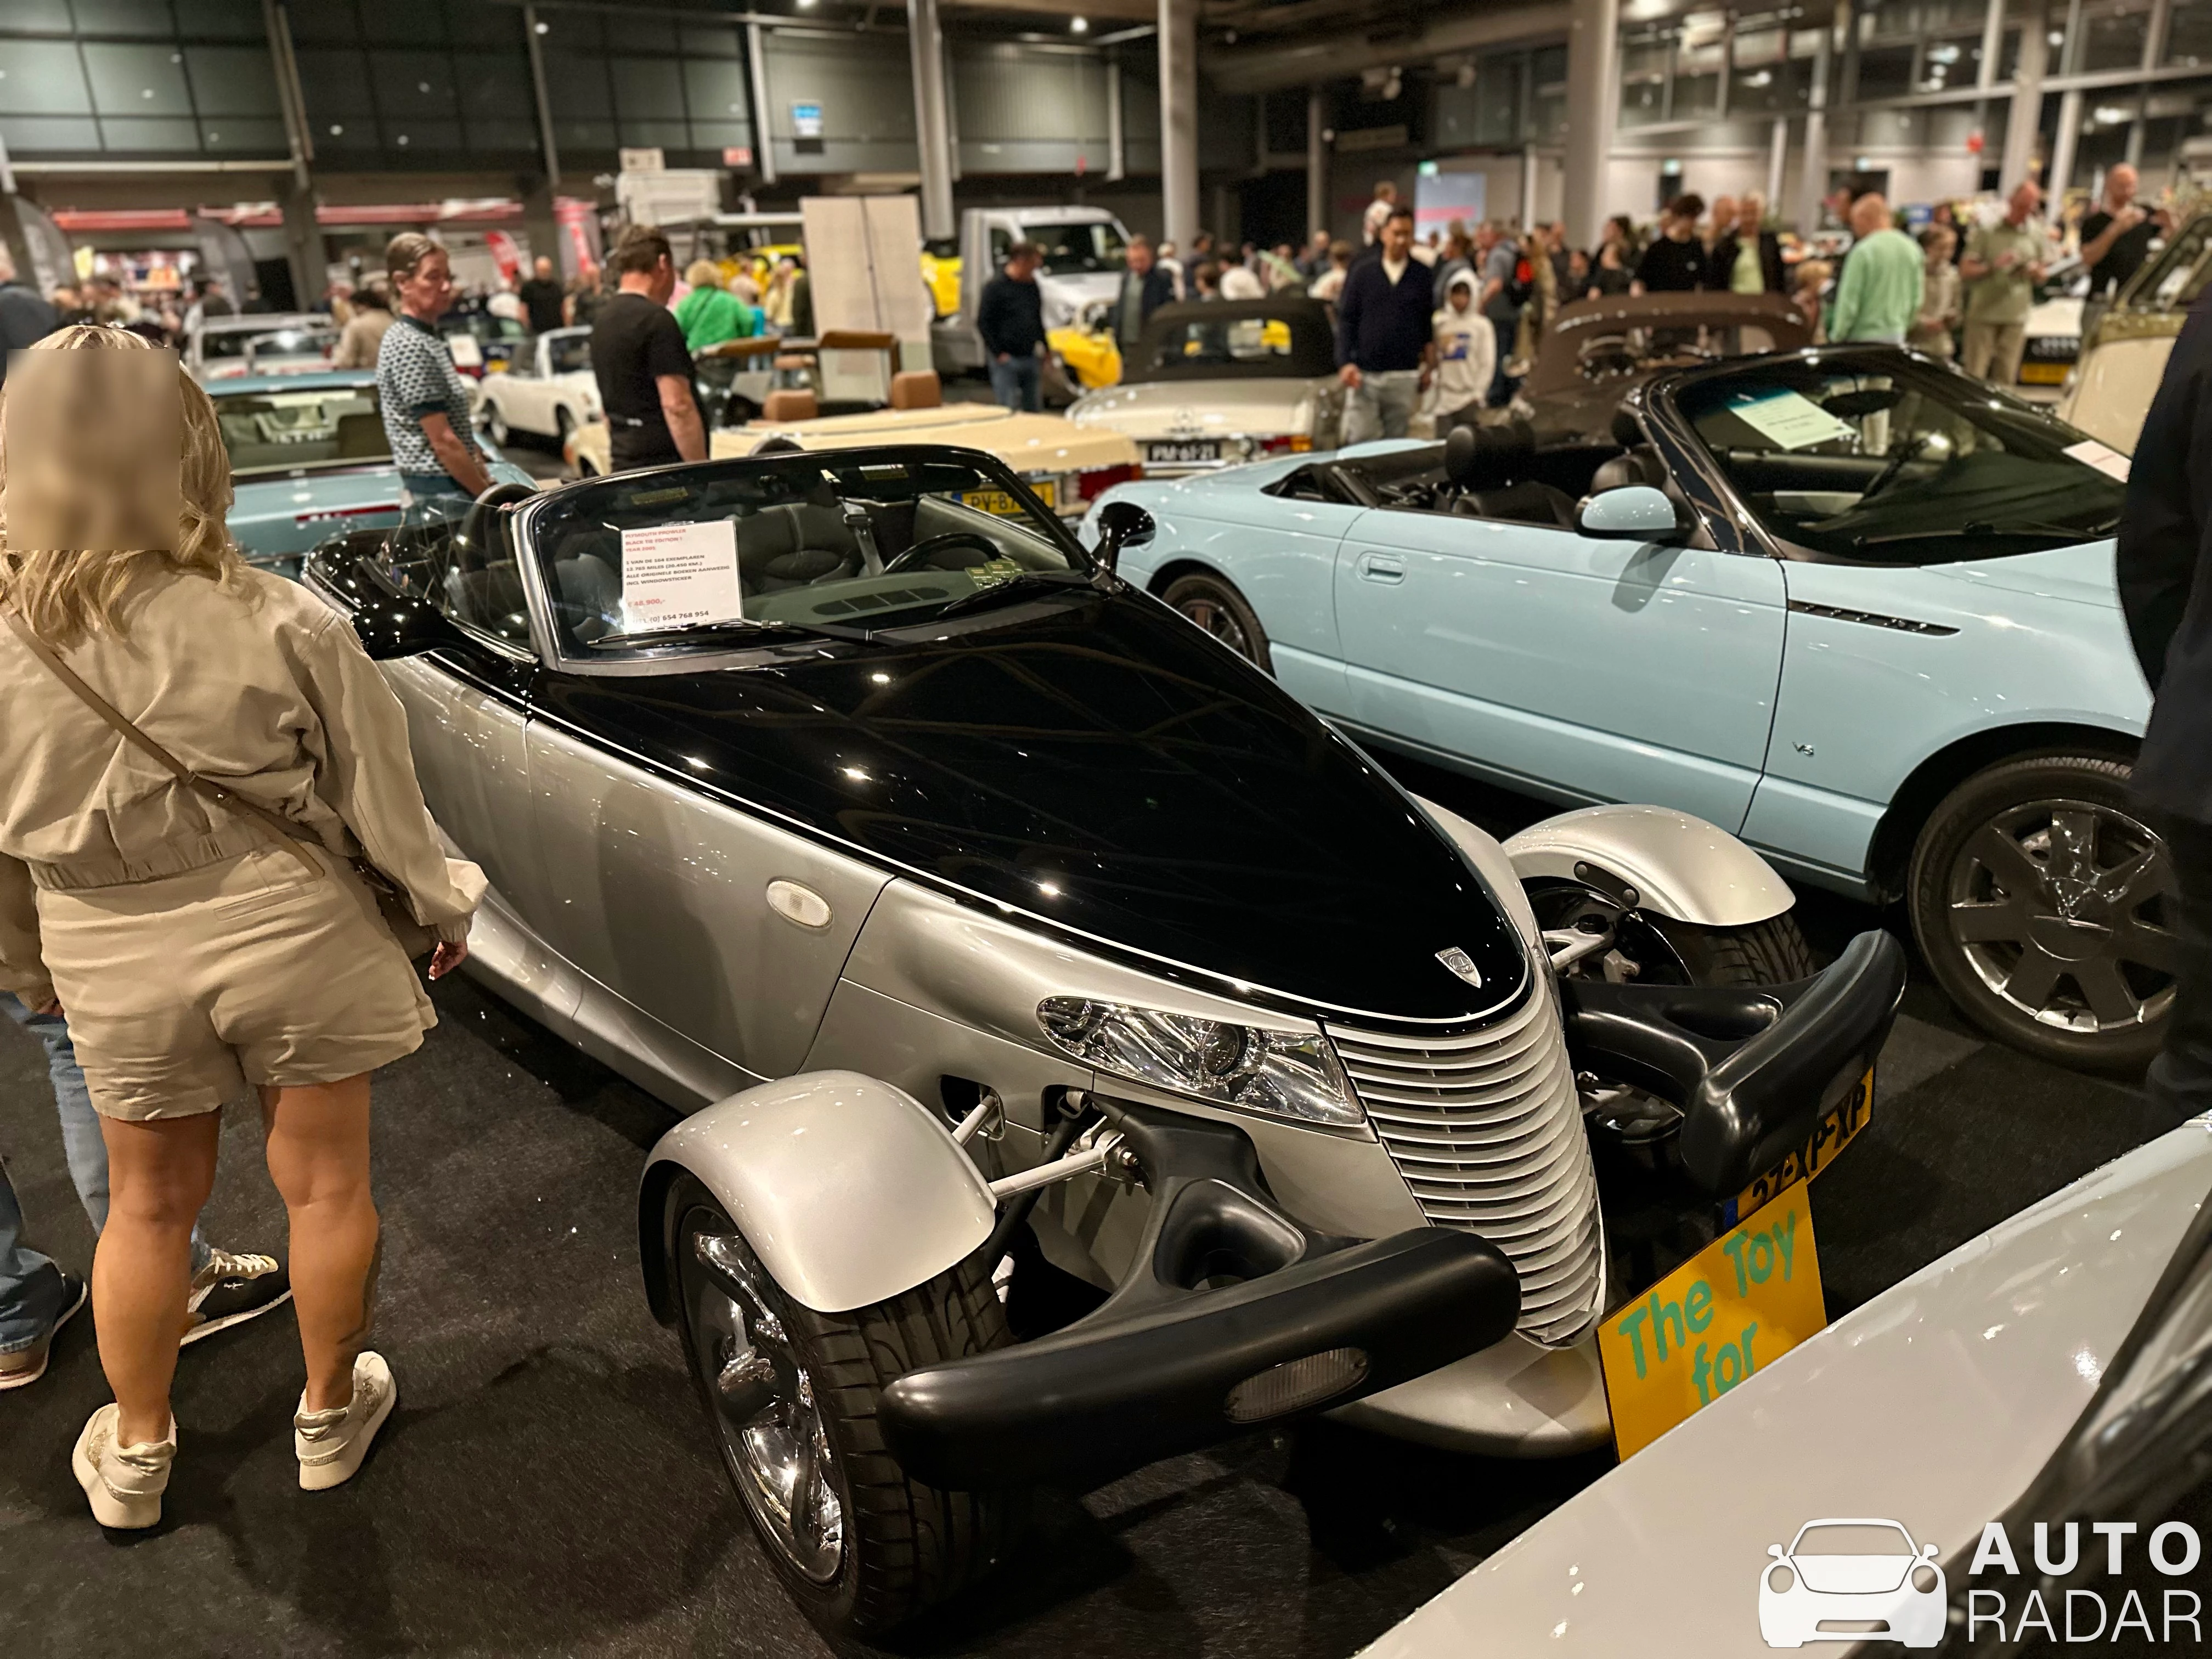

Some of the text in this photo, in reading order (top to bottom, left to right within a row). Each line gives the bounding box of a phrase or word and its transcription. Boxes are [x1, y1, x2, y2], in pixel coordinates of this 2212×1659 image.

[641, 576, 692, 584] WINDOWSTICKER
[1618, 1209, 1796, 1380] The Toy
[1692, 1321, 1758, 1406] for
